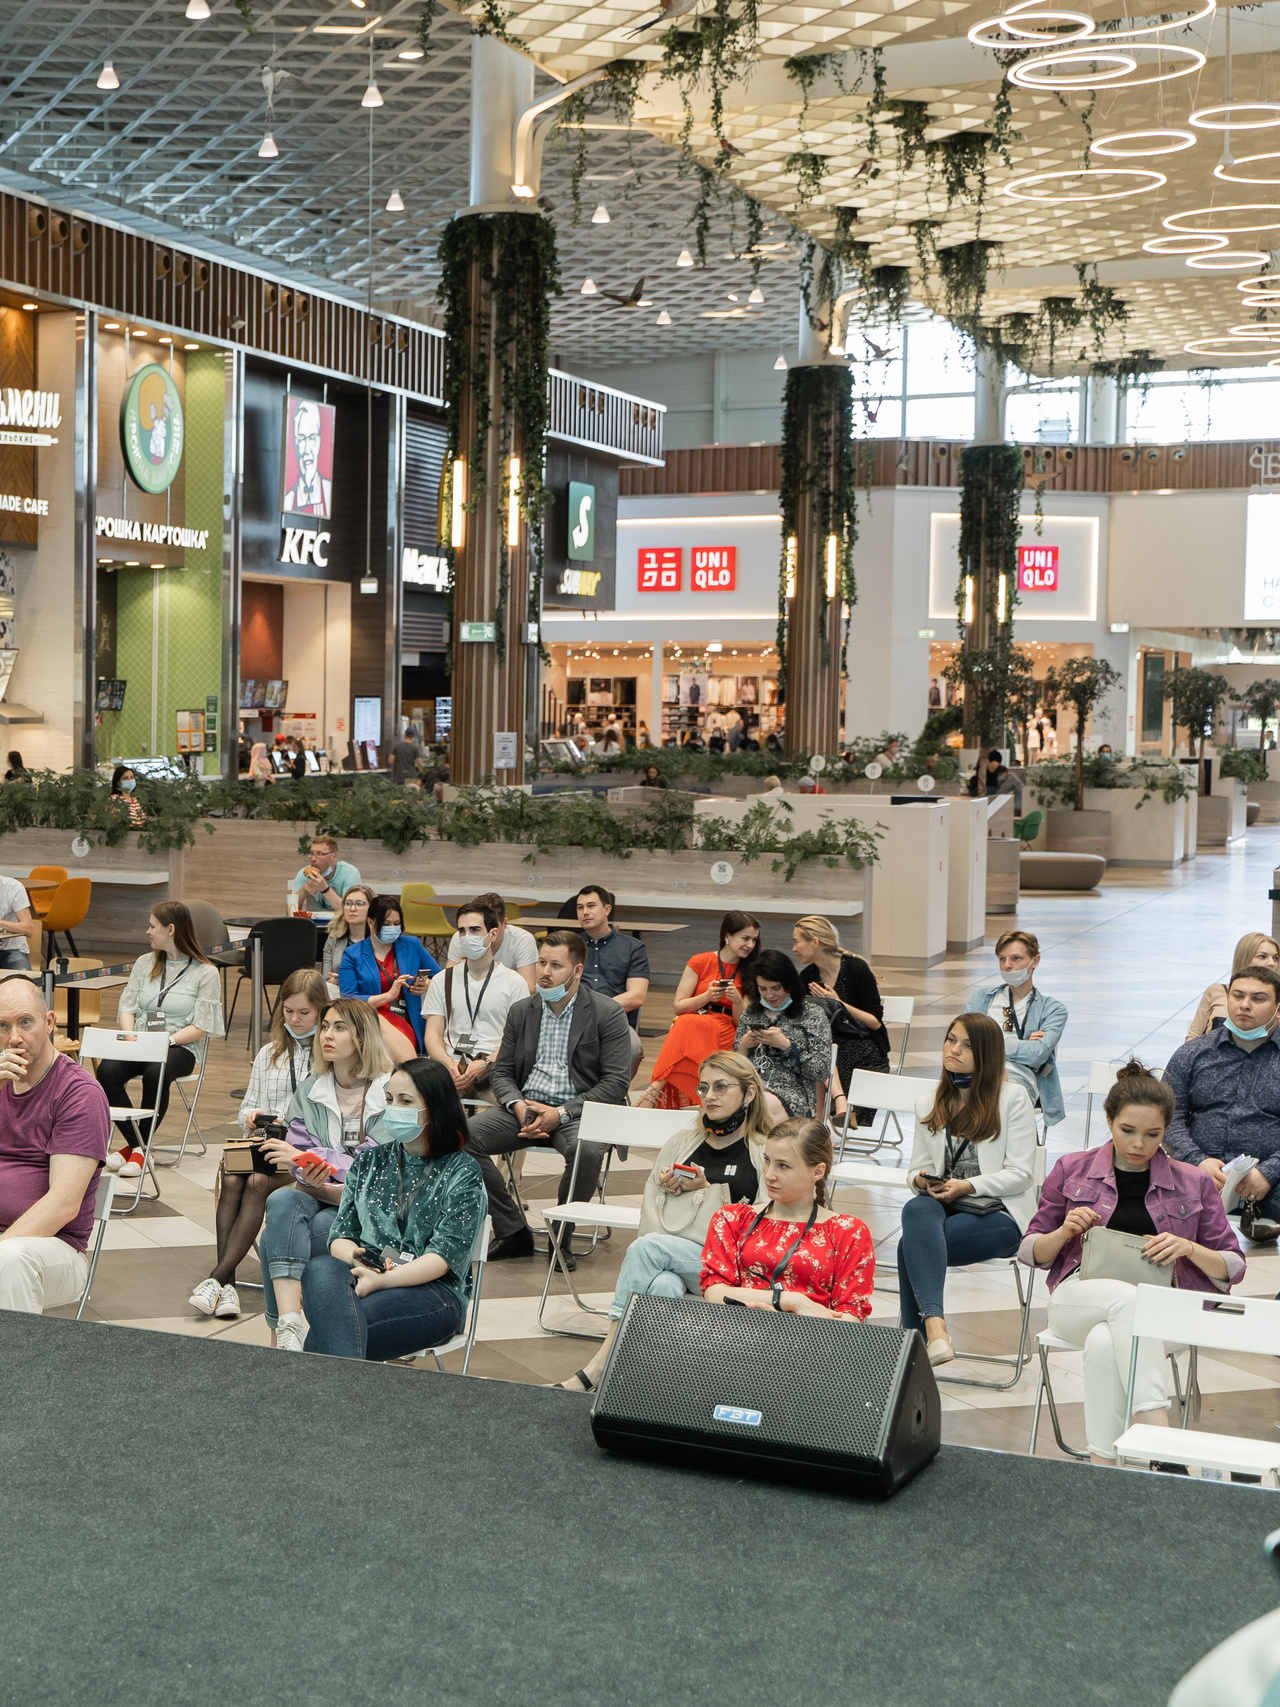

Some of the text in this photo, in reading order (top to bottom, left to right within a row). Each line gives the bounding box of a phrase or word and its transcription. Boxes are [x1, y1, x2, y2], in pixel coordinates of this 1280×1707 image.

[23, 498, 49, 516] CAFE
[95, 515, 141, 541] РОШКА
[281, 527, 331, 567] KFC
[695, 551, 728, 568] UNI
[1023, 550, 1053, 568] UNI
[560, 567, 601, 597] SUBWAY
[695, 569, 731, 589] QLO
[1023, 568, 1055, 588] QLO
[718, 1407, 757, 1421] FBT
